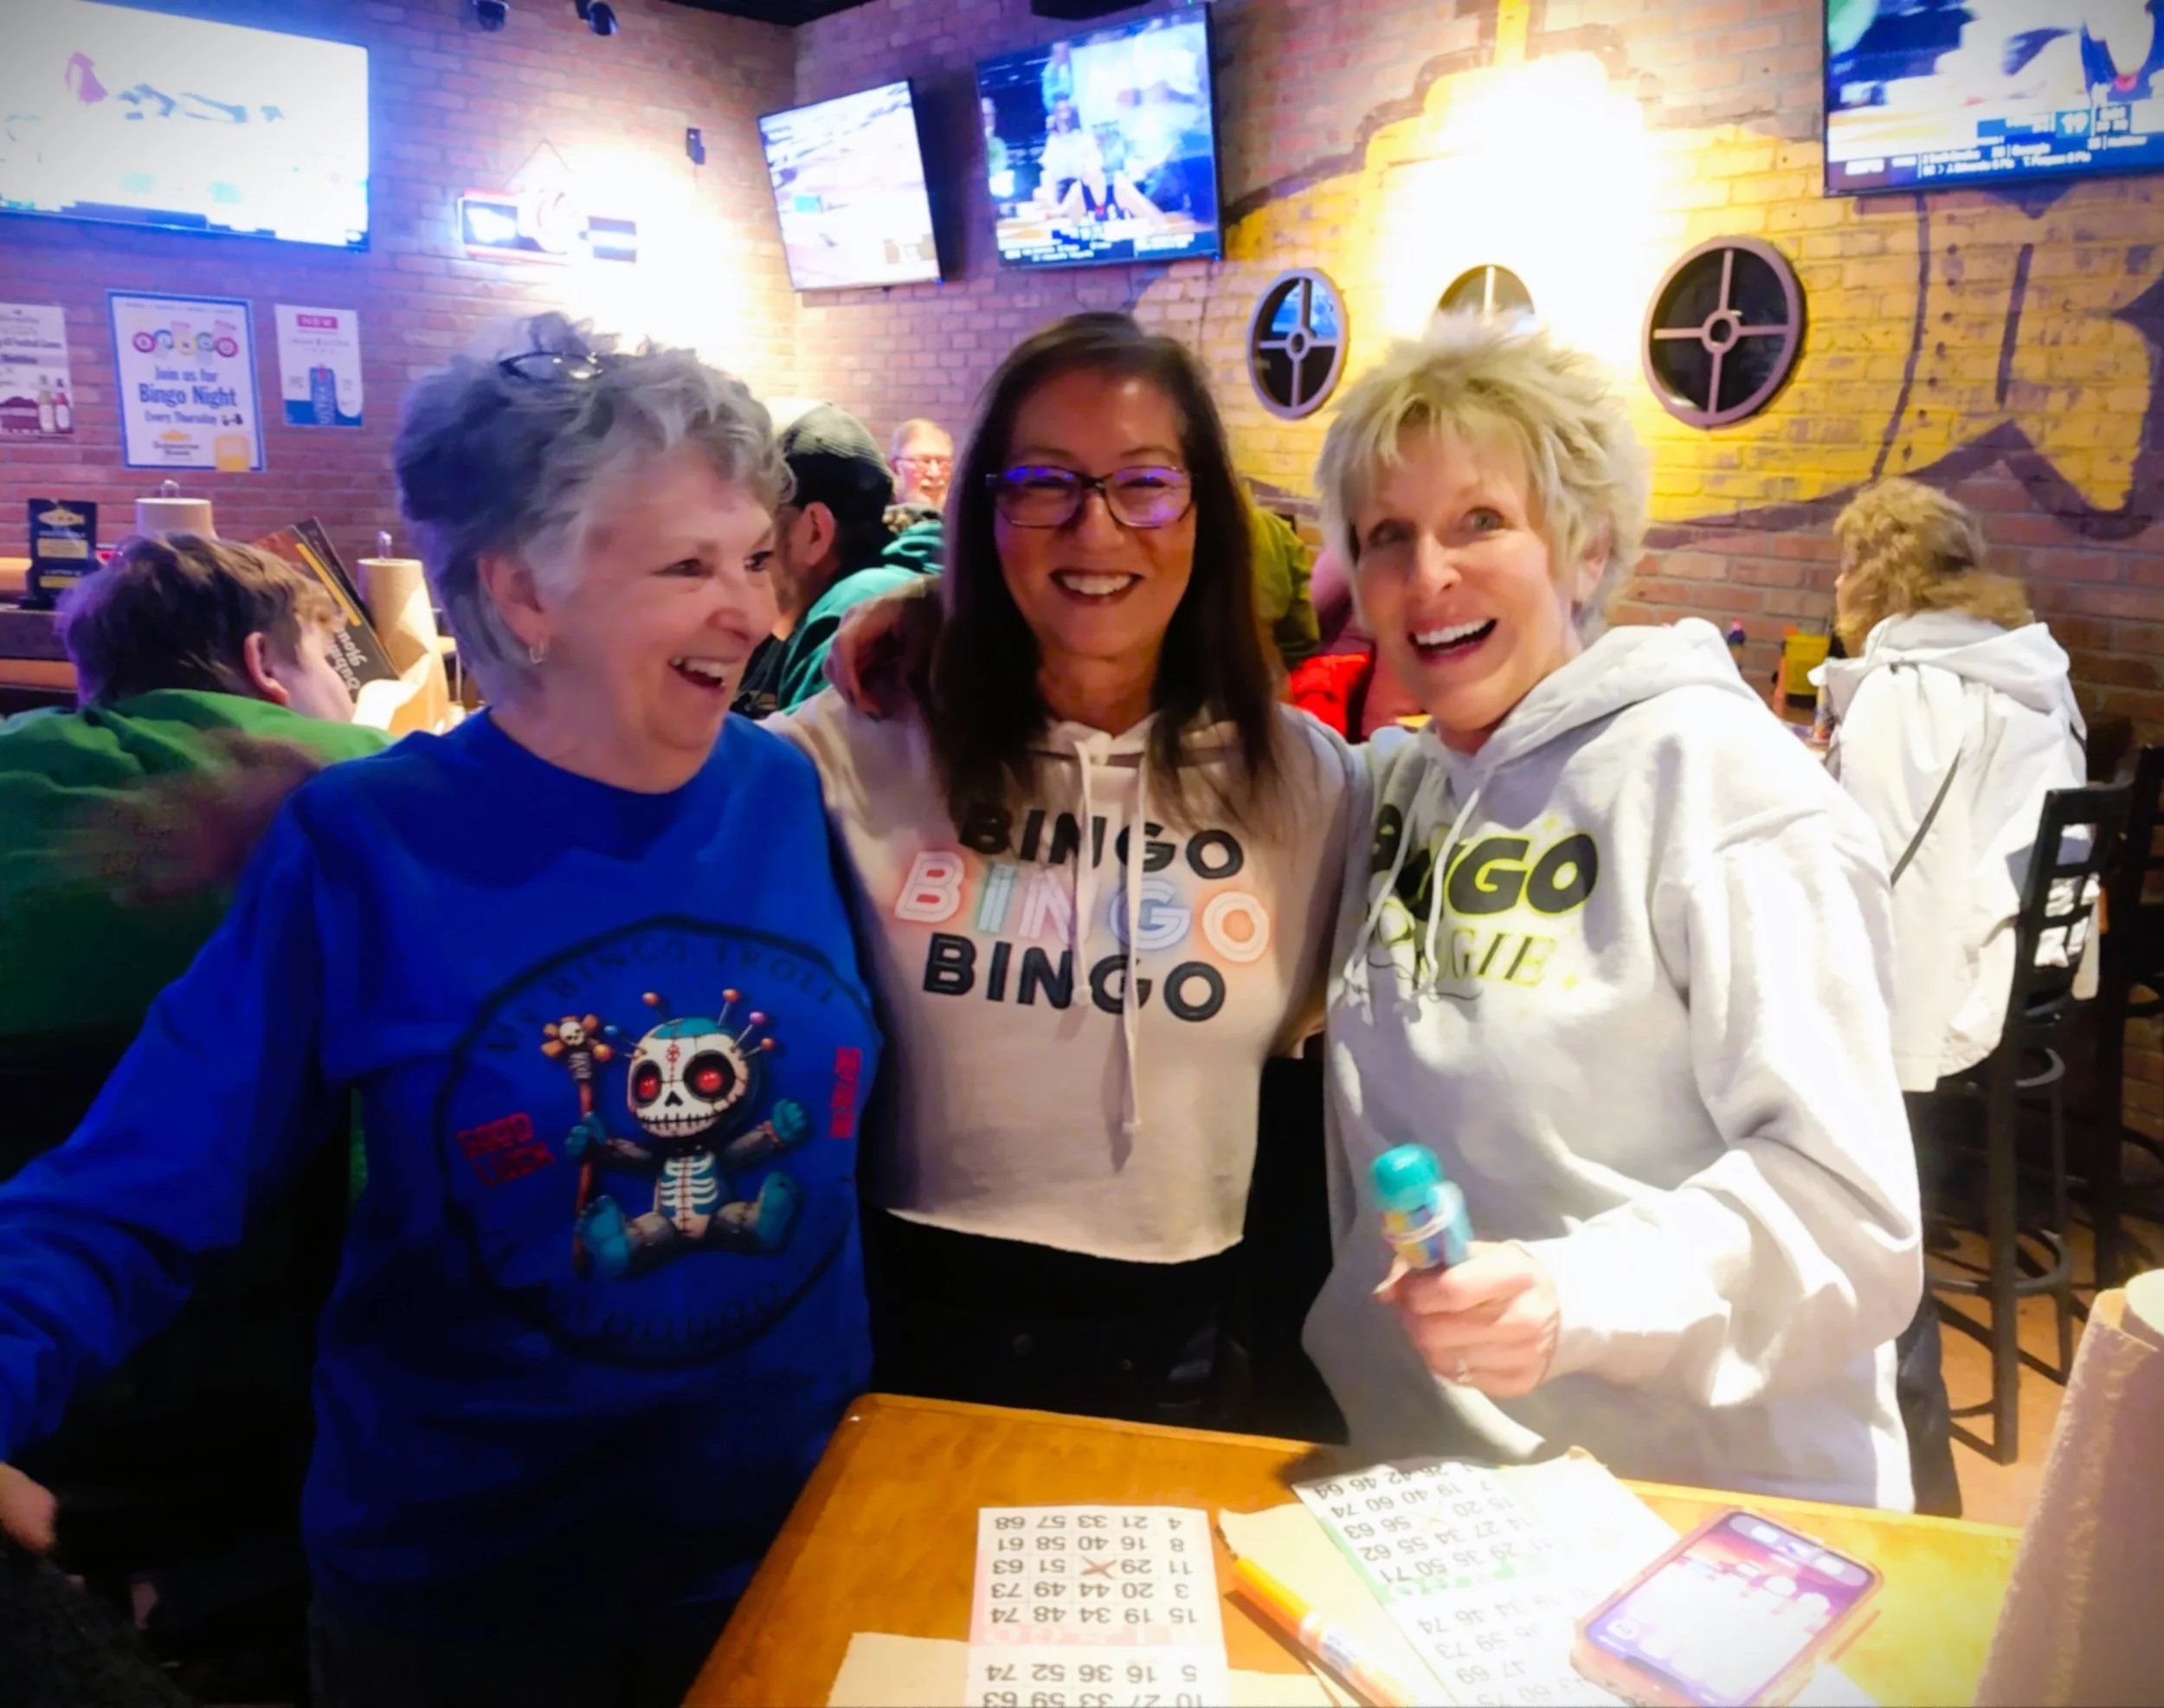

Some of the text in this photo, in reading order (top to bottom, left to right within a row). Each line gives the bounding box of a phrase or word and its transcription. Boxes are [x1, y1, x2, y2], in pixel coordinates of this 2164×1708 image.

[300, 317, 334, 327] NEW
[155, 365, 217, 382] Join us for
[138, 383, 237, 409] Bingo Night
[145, 410, 171, 423] Every
[337, 631, 368, 667] Hou
[959, 803, 1244, 880] BINGO
[1372, 803, 1599, 922] BGO
[894, 851, 1271, 964] BINGO
[546, 936, 689, 1001] BINGO
[923, 932, 1227, 1023] BINGO
[1314, 1484, 1344, 1501] 64
[1349, 1476, 1377, 1492] 46
[1365, 1497, 1395, 1511] 60
[1401, 1489, 1428, 1505] 40
[1330, 1503, 1358, 1518] 74
[1453, 1499, 1482, 1515] 20
[995, 1515, 1182, 1531] 4 21 33 57 68
[1343, 1523, 1375, 1540] 63
[1381, 1516, 1412, 1531] 56
[1474, 1521, 1500, 1538] 27
[997, 1537, 1184, 1552] 8 16 40 58 61
[1397, 1537, 1429, 1554] 55
[1434, 1529, 1465, 1545] 34
[1359, 1544, 1391, 1562] 62
[1452, 1550, 1485, 1567] 35
[1489, 1543, 1521, 1561] 29
[993, 1559, 1191, 1576] 11 29 51 63
[1379, 1566, 1414, 1584] 71
[1415, 1558, 1446, 1576] 50
[991, 1582, 1188, 1600] 3 20 44 49 73
[989, 1606, 1197, 1624] 15 19 34 48 74
[1418, 1617, 1451, 1634] 74
[1475, 1631, 1508, 1652] 59
[1435, 1641, 1471, 1660] 73
[985, 1664, 1197, 1684] 5 16 36 52 74
[1457, 1666, 1490, 1685] 69
[982, 1691, 1018, 1708] 63
[1030, 1692, 1066, 1708] 59
[1079, 1692, 1114, 1708] 33
[1129, 1692, 1161, 1708] 27
[1517, 1684, 1552, 1704] 60
